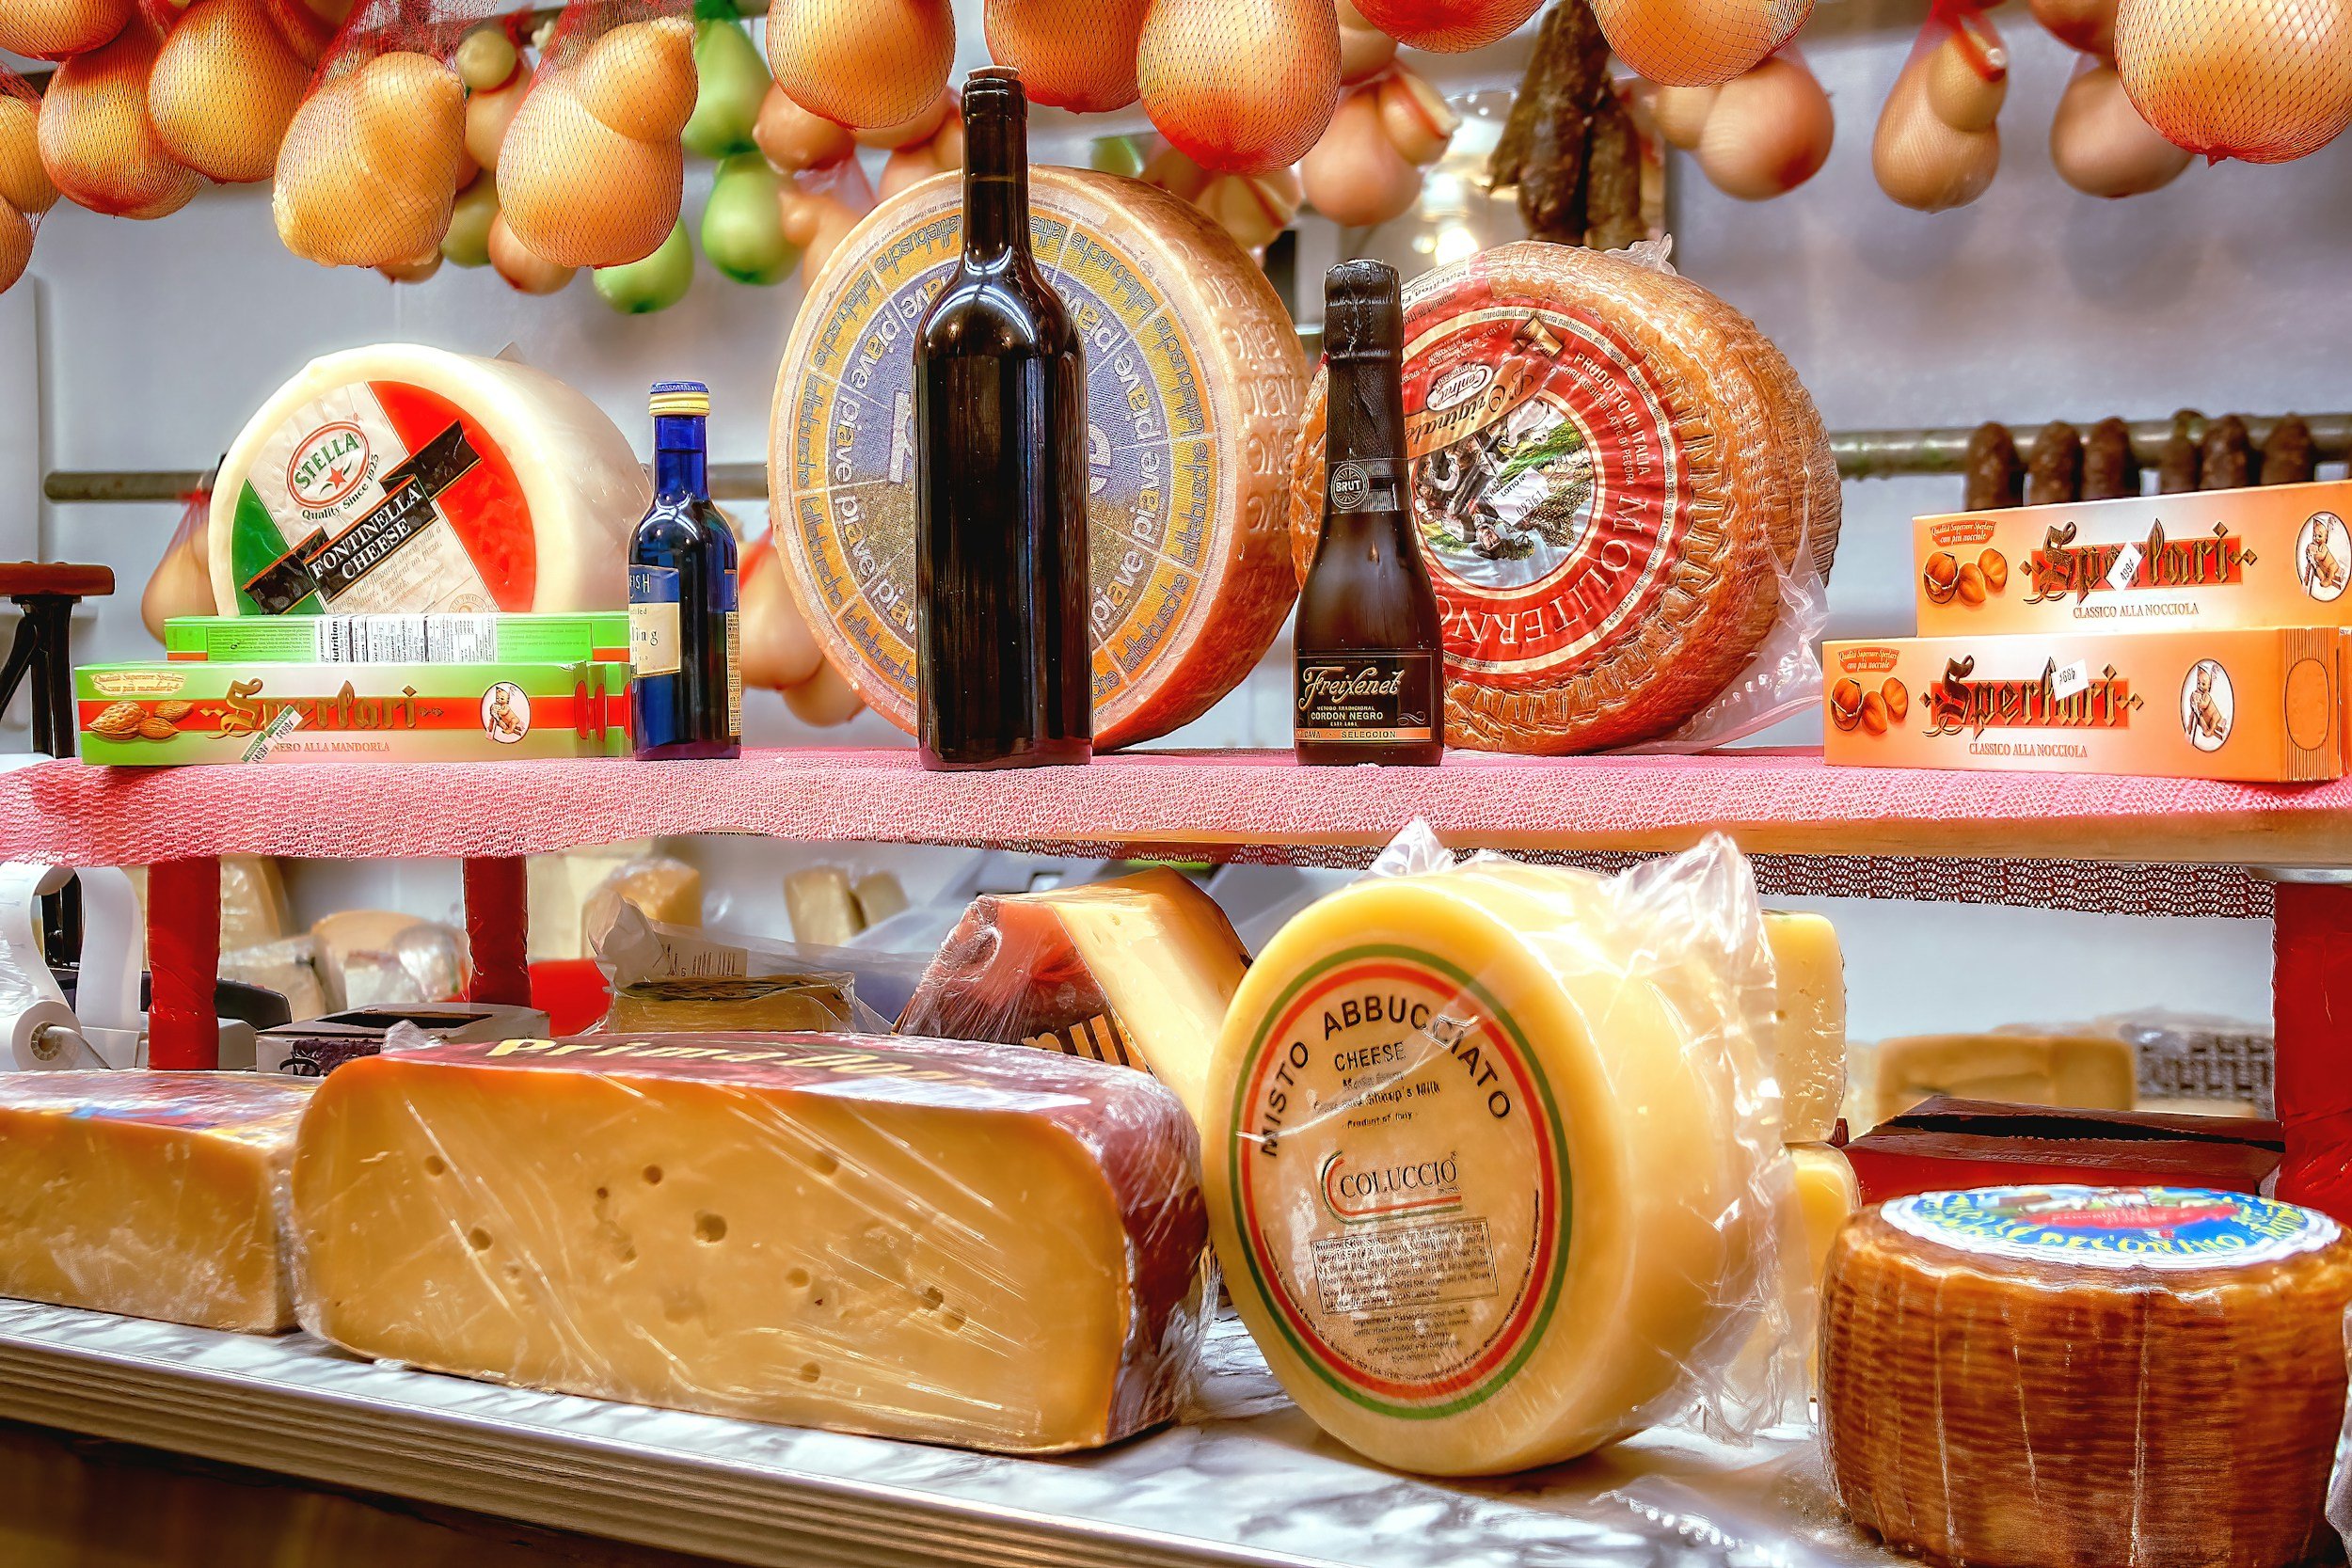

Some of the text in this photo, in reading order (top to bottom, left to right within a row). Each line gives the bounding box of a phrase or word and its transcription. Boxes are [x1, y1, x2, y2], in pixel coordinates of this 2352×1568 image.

[875, 214, 963, 275] lattebusche
[1071, 232, 1157, 325] lattebusche
[813, 270, 880, 369] lattebusche
[900, 275, 950, 319] ave
[1056, 284, 1122, 355] piave
[850, 309, 901, 389] piave
[1152, 316, 1204, 437] lattebusche
[797, 375, 828, 488] lattebusche
[1113, 352, 1162, 440] piave
[1559, 363, 1635, 486] FORMAGGIO DI LATTE DI PECORA
[1573, 351, 1651, 476] PRODOTTO IN ITALIA
[294, 433, 359, 489] STELLA
[834, 395, 862, 483] piave
[302, 507, 340, 520] Quality
[342, 483, 369, 509] Since
[1129, 450, 1161, 544] piave
[1170, 442, 1208, 567] lattebusche
[1336, 480, 1360, 492] BRUT
[1500, 479, 1520, 498] LOTTO
[310, 487, 422, 579] FONTINELLA
[342, 518, 411, 579] CHEESE
[800, 496, 842, 608] lattebusche
[834, 496, 876, 577] piave
[870, 578, 915, 634] piav
[1091, 550, 1144, 633] piave
[1113, 575, 1189, 674] lattebusche
[2073, 602, 2199, 619] CLASSICO ALLA NOCCIOLA
[631, 628, 658, 646] ling
[842, 604, 916, 693] lattebusche
[1298, 666, 1406, 711] Freixenet
[1311, 712, 1384, 721] CORDON NEGRO
[273, 742, 390, 752] NERO ALLA MANDORLA
[1969, 743, 2088, 757] CLASSICO ALLA NOCCIOLA
[485, 1037, 787, 1061] Prima
[1262, 1040, 1310, 1157] MISTO
[1322, 995, 1511, 1120] ABBUCCIATO
[1334, 1041, 1406, 1071] CHEESE
[1340, 1159, 1456, 1198] COLUCCIO
